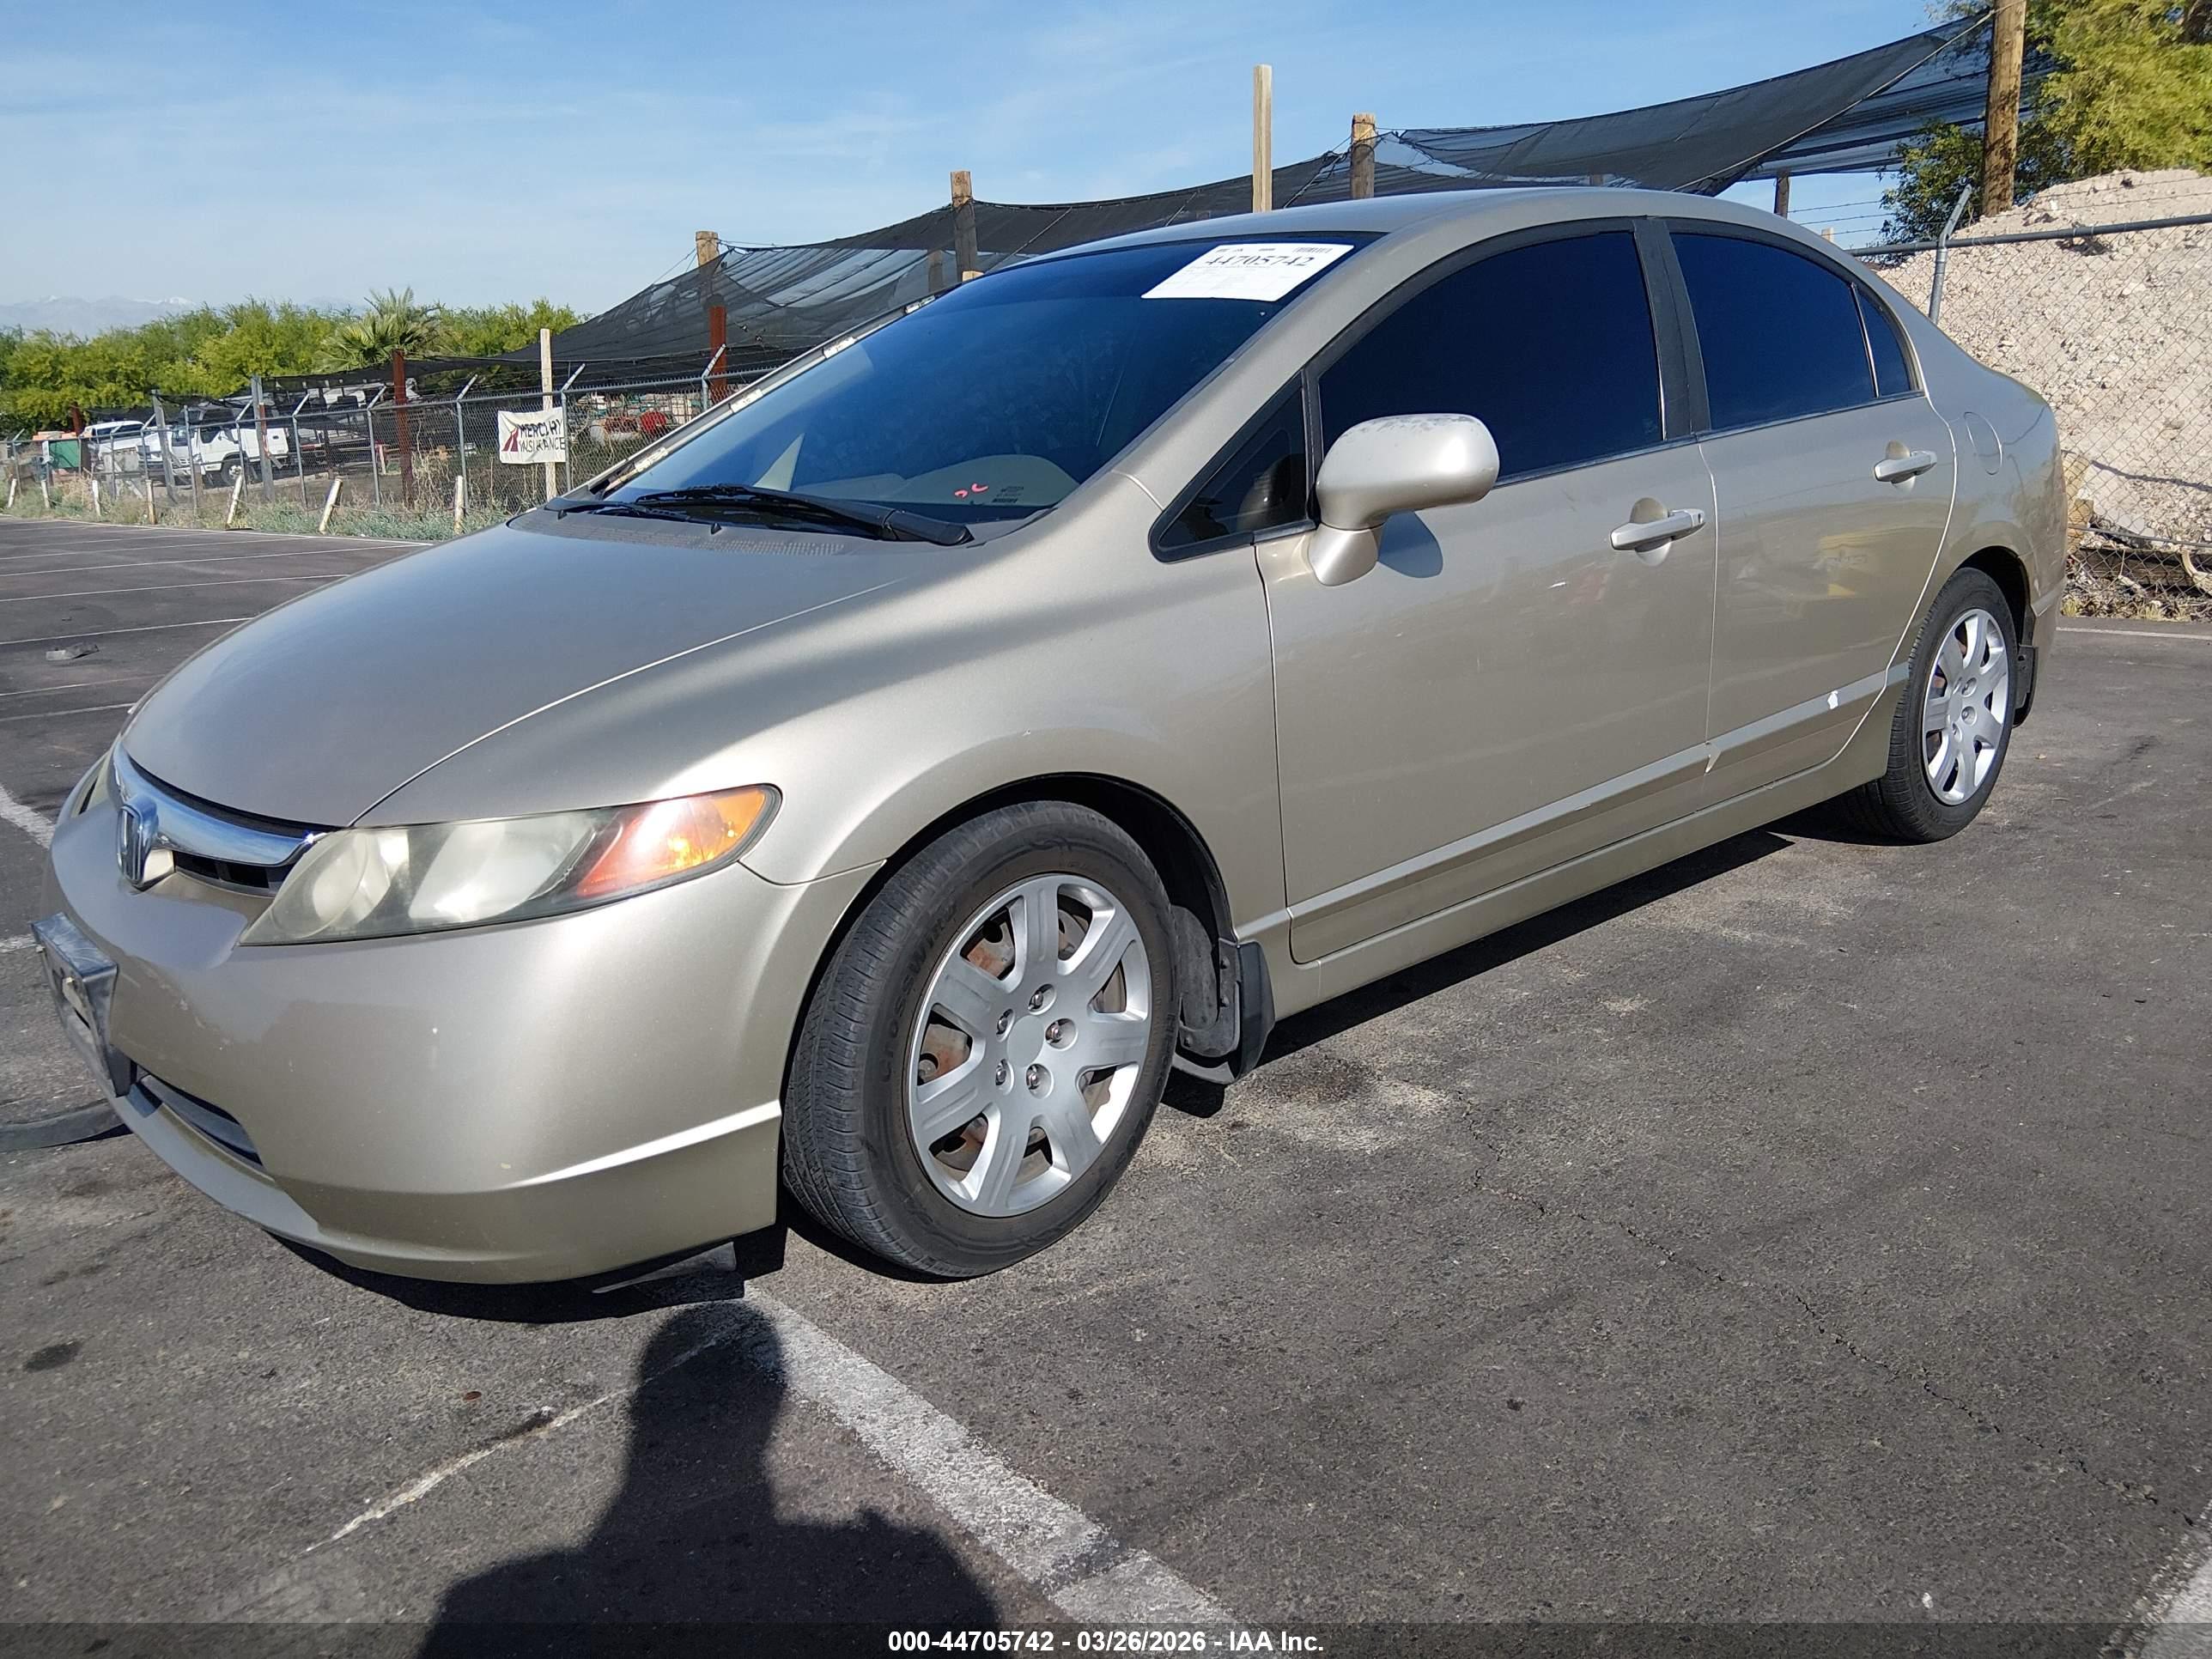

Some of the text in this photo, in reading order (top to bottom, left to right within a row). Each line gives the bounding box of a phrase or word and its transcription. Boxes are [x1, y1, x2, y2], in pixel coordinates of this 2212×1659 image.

[1206, 255, 1316, 266] 44705742
[518, 419, 562, 438] MERCURY
[520, 436, 566, 452] INSURANCE
